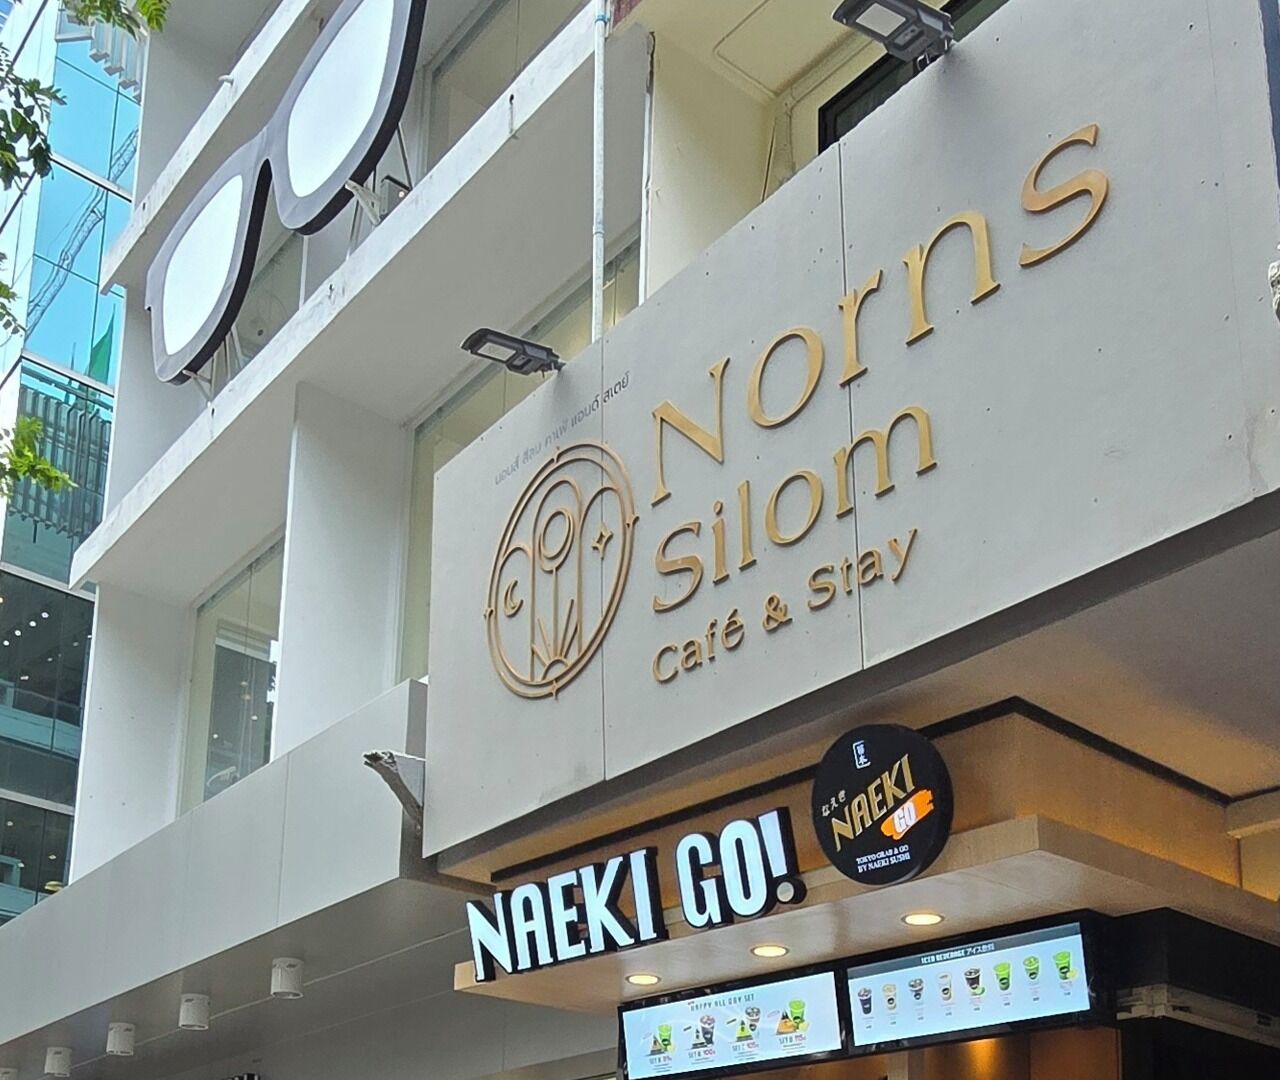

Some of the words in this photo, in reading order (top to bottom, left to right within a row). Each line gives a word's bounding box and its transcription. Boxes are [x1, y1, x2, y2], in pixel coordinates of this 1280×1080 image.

[650, 123, 1109, 507] Norns
[653, 405, 939, 614] Silom
[653, 607, 745, 683] Café
[762, 592, 793, 633] &
[807, 527, 919, 611] Stay
[831, 753, 916, 854] NAEKI
[892, 799, 918, 834] GO
[465, 846, 664, 984] NAEKI
[675, 808, 800, 930] GO!
